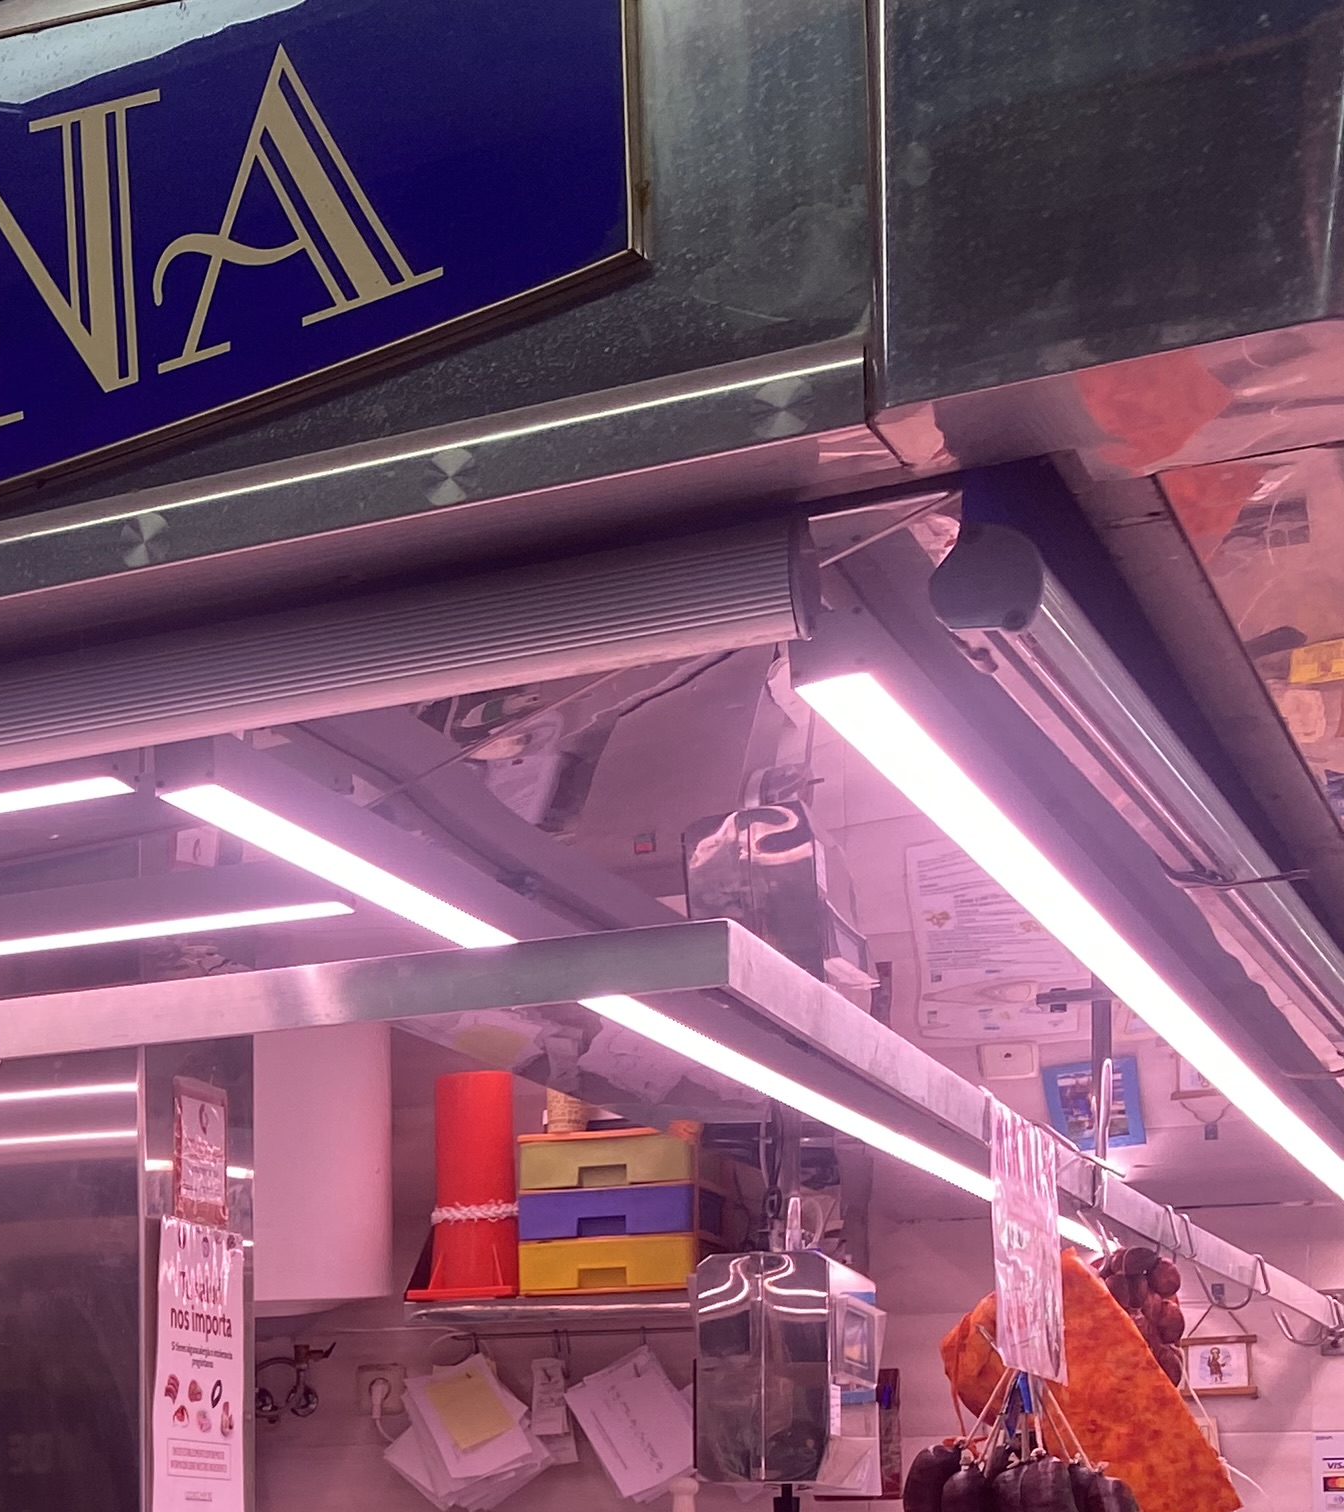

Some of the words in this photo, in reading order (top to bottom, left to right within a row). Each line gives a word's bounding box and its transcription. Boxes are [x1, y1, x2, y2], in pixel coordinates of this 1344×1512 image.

[170, 1307, 190, 1331] nos
[191, 1305, 233, 1342] importa
[1327, 1462, 1344, 1470] VIS
